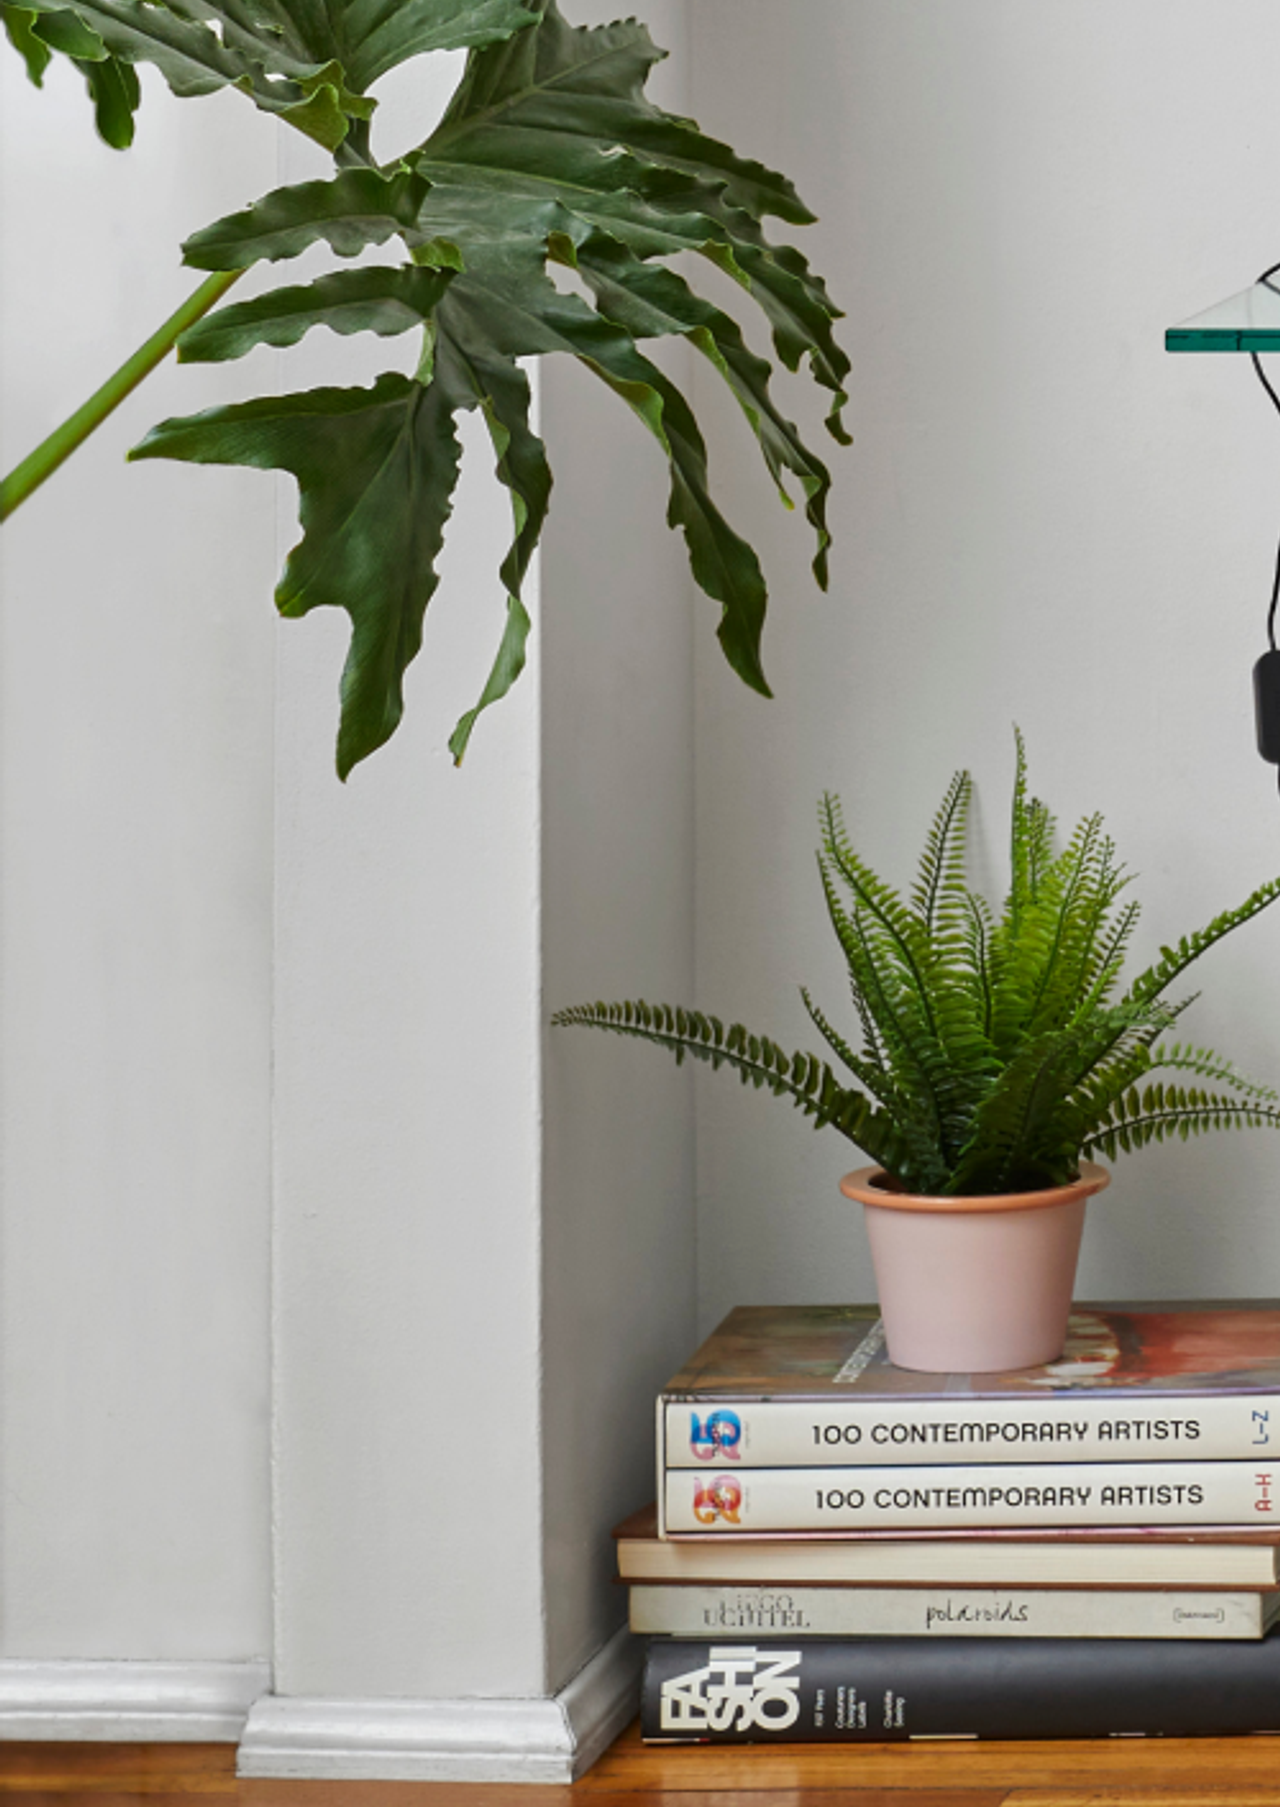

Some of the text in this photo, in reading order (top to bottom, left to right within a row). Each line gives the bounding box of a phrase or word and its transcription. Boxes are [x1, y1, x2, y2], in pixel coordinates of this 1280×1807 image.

[812, 1419, 1201, 1445] 100 CONTEMPORARY ARTISTS
[816, 1484, 1204, 1510] 100 CONTEMPORARY ARTISTS
[925, 1598, 1029, 1630] polaroids
